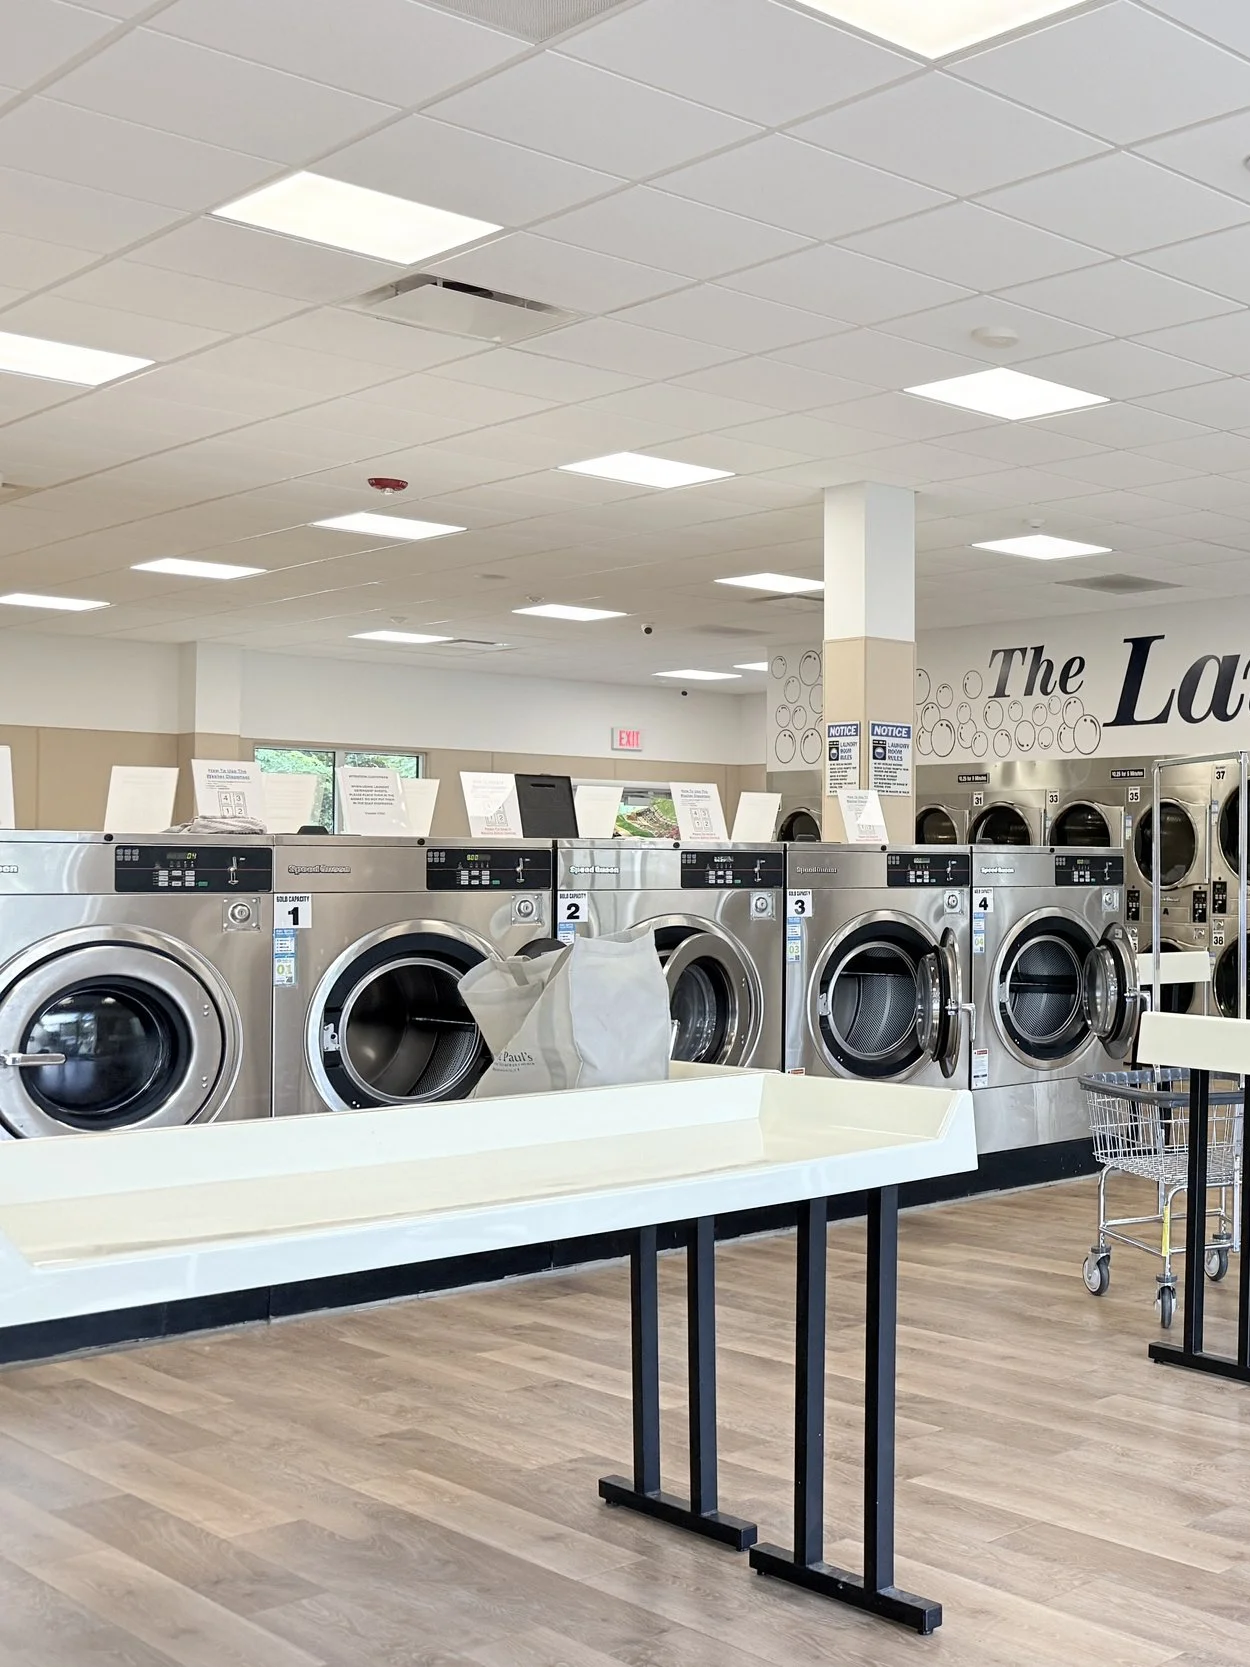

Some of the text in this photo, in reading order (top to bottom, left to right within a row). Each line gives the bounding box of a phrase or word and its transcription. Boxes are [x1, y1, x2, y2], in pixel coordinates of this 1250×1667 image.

[987, 645, 1085, 699] The
[829, 725, 857, 737] NOTICE
[873, 725, 908, 737] NOTICE
[618, 730, 640, 748] EXIT
[1216, 770, 1226, 780] 37
[975, 796, 982, 805] 31
[1050, 794, 1058, 803] 33
[1130, 792, 1139, 800] 35
[288, 864, 319, 875] Speed
[569, 864, 620, 875] Speed Queen
[980, 867, 998, 875] Speed
[794, 899, 806, 915] 3
[978, 896, 988, 910] 4
[287, 906, 299, 925] 1
[566, 902, 580, 920] 2
[1213, 936, 1223, 945] 38
[789, 945, 800, 954] 03
[276, 964, 292, 975] 01
[503, 1050, 534, 1063] Paul's
